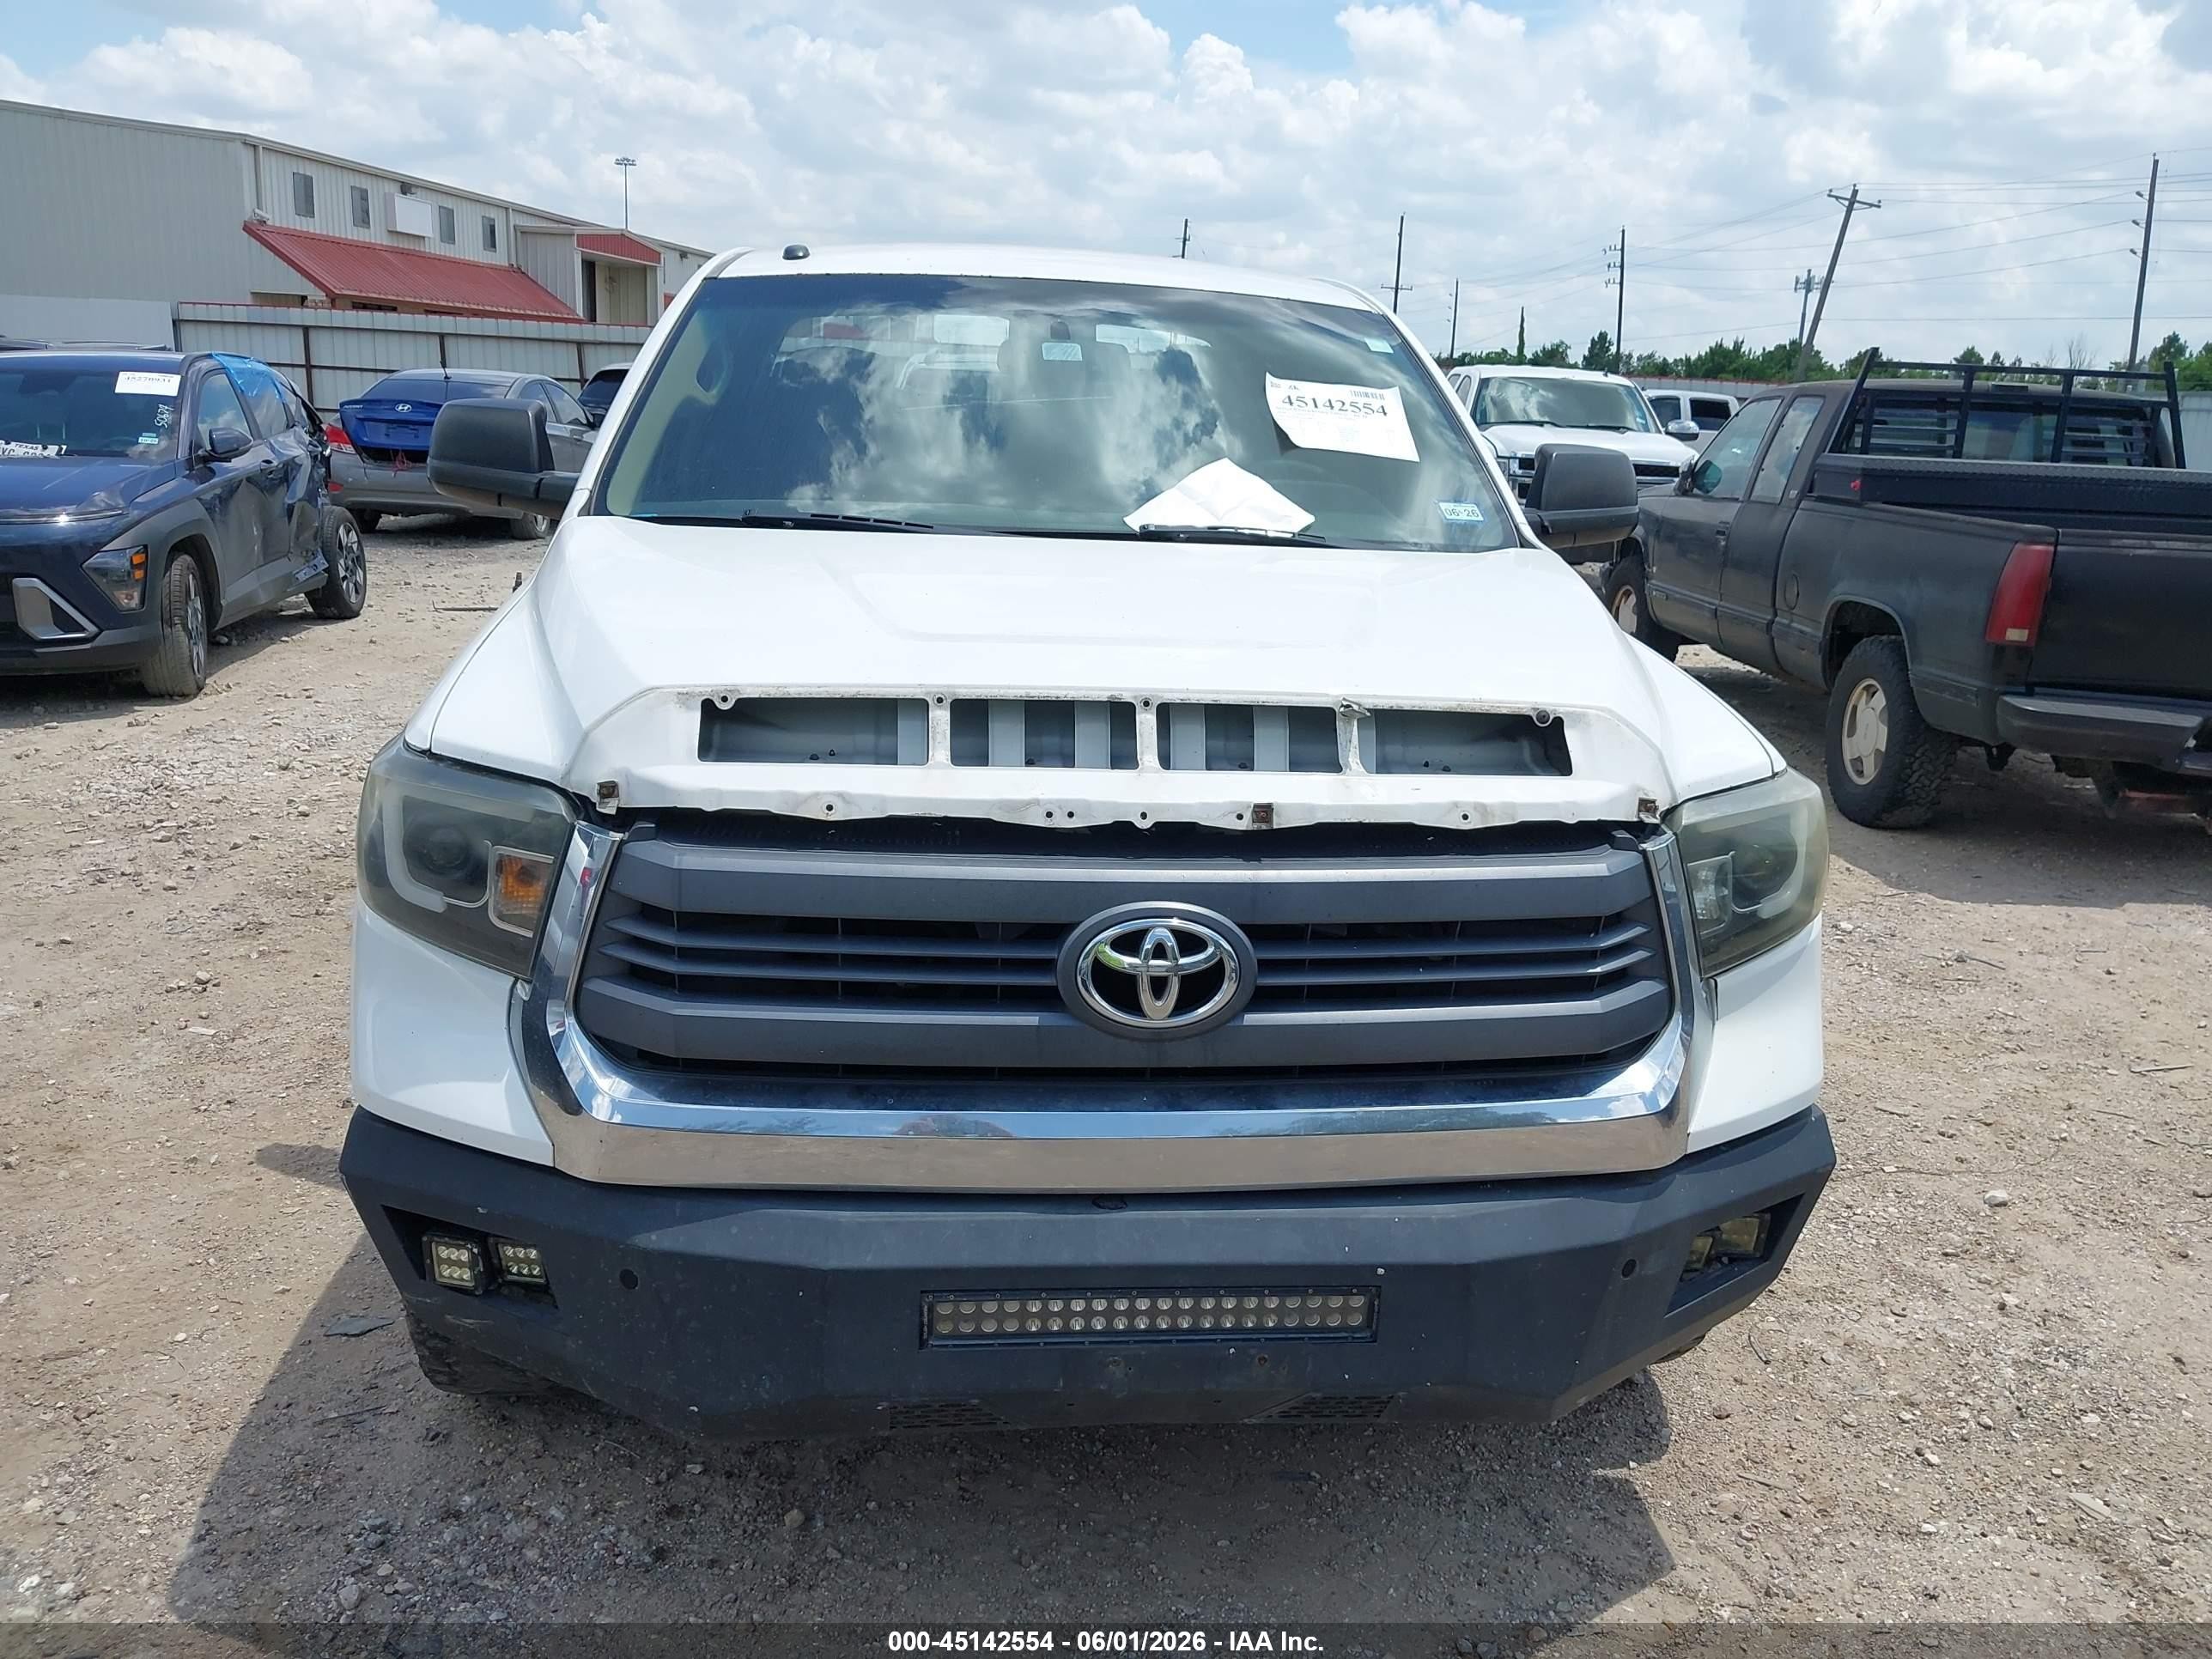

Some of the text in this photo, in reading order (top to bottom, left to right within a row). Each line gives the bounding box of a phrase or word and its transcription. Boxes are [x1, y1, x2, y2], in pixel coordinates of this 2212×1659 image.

[1282, 394, 1388, 416] 45142554
[1444, 508, 1479, 518] 06 26
